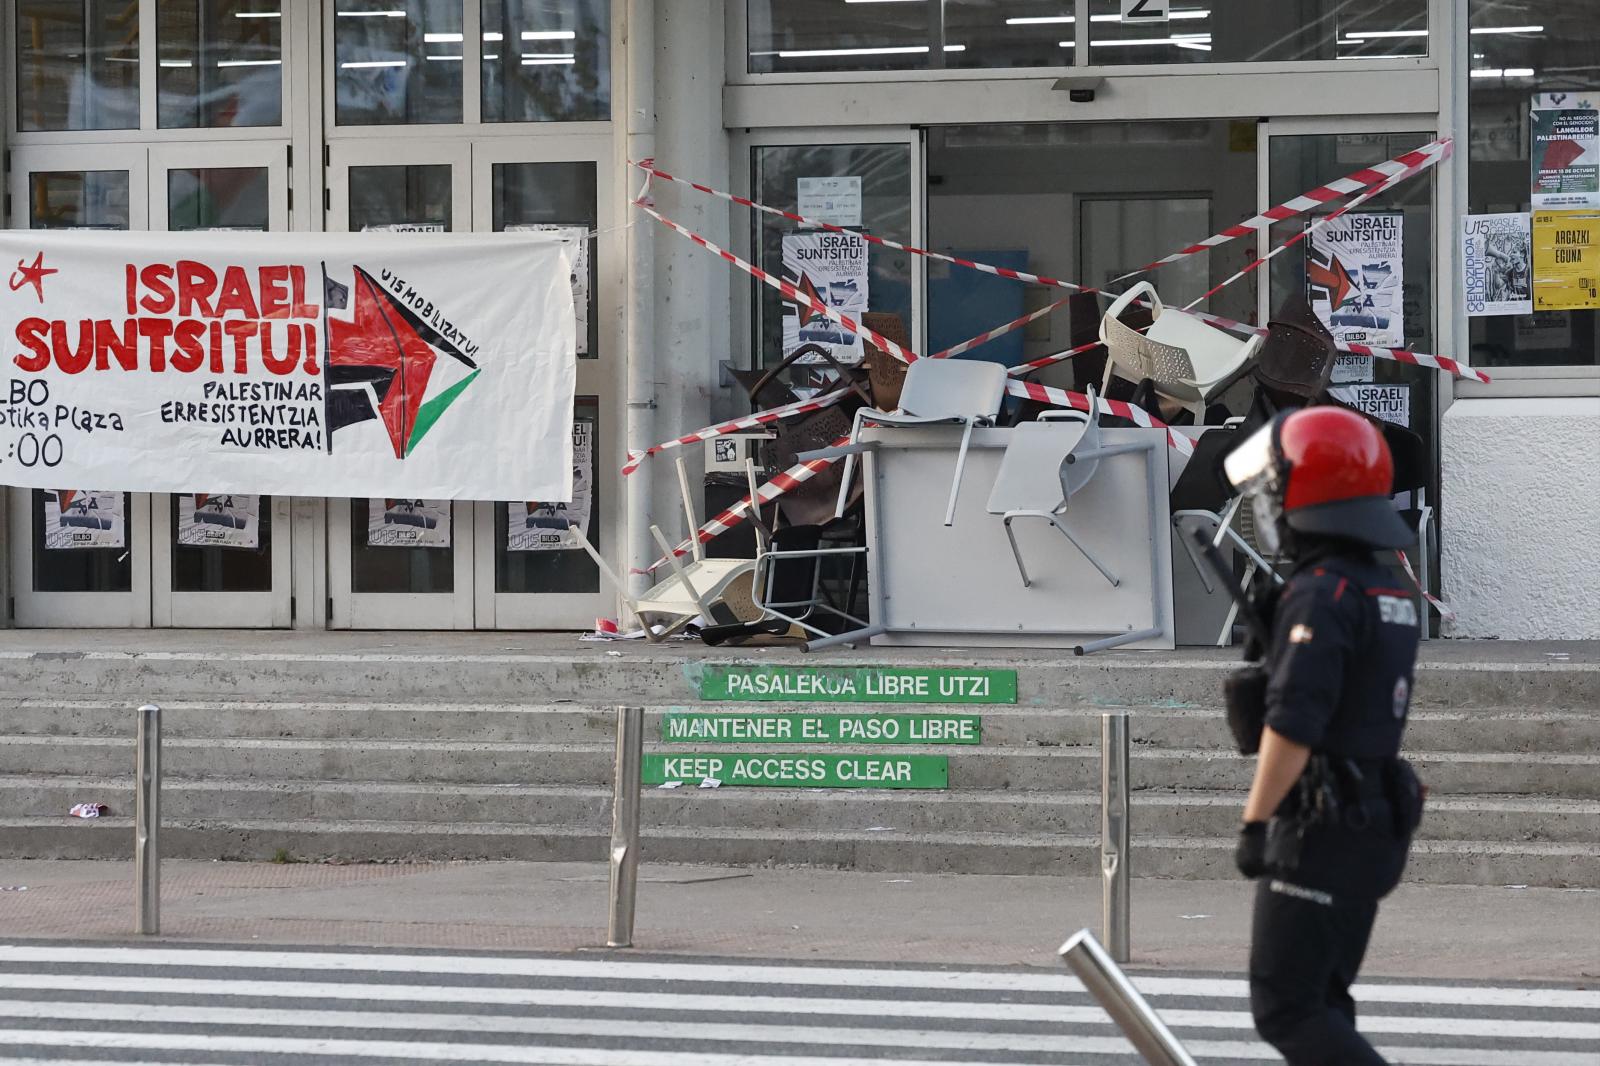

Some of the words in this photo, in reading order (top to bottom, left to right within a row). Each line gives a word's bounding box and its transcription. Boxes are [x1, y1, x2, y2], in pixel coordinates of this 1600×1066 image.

[1556, 126, 1595, 134] LANGILEOK
[1351, 216, 1397, 230] ISRAEL
[1465, 220, 1490, 236] U15
[820, 236, 863, 248] ISRAEL
[1326, 229, 1397, 242] SUNTSITU!
[1555, 230, 1590, 244] ARGAZKI
[796, 248, 863, 260] SUNTSITU!
[1555, 249, 1582, 263] EGUNA
[1465, 237, 1476, 313] GENOZIDIOA
[1475, 258, 1485, 313] GELDITU!
[126, 260, 320, 319] ISRAEL
[401, 286, 480, 357] MOBILIZATU!
[13, 317, 321, 376] SUNTSITU!
[1345, 332, 1367, 341] BILBO
[1336, 356, 1369, 366] NTSITU!
[0, 379, 49, 406] BO
[203, 381, 323, 402] PALESTINAR
[1357, 388, 1404, 401] ISRAEL
[160, 401, 320, 428] ERRESISTENTZIA
[1346, 400, 1403, 413] NTSITU!
[55, 404, 124, 433] Plaza
[221, 427, 321, 450] AURRERA!
[0, 432, 63, 467] :00
[866, 675, 929, 696] LIBRE
[939, 676, 990, 697] UTZI
[669, 718, 792, 738] MANTENER
[802, 718, 830, 738] EL
[839, 718, 900, 739] PASO
[909, 719, 974, 740] LIBRE
[664, 758, 723, 779] KEEP
[732, 759, 827, 780] ACCESS
[836, 760, 912, 781] CLEAR
